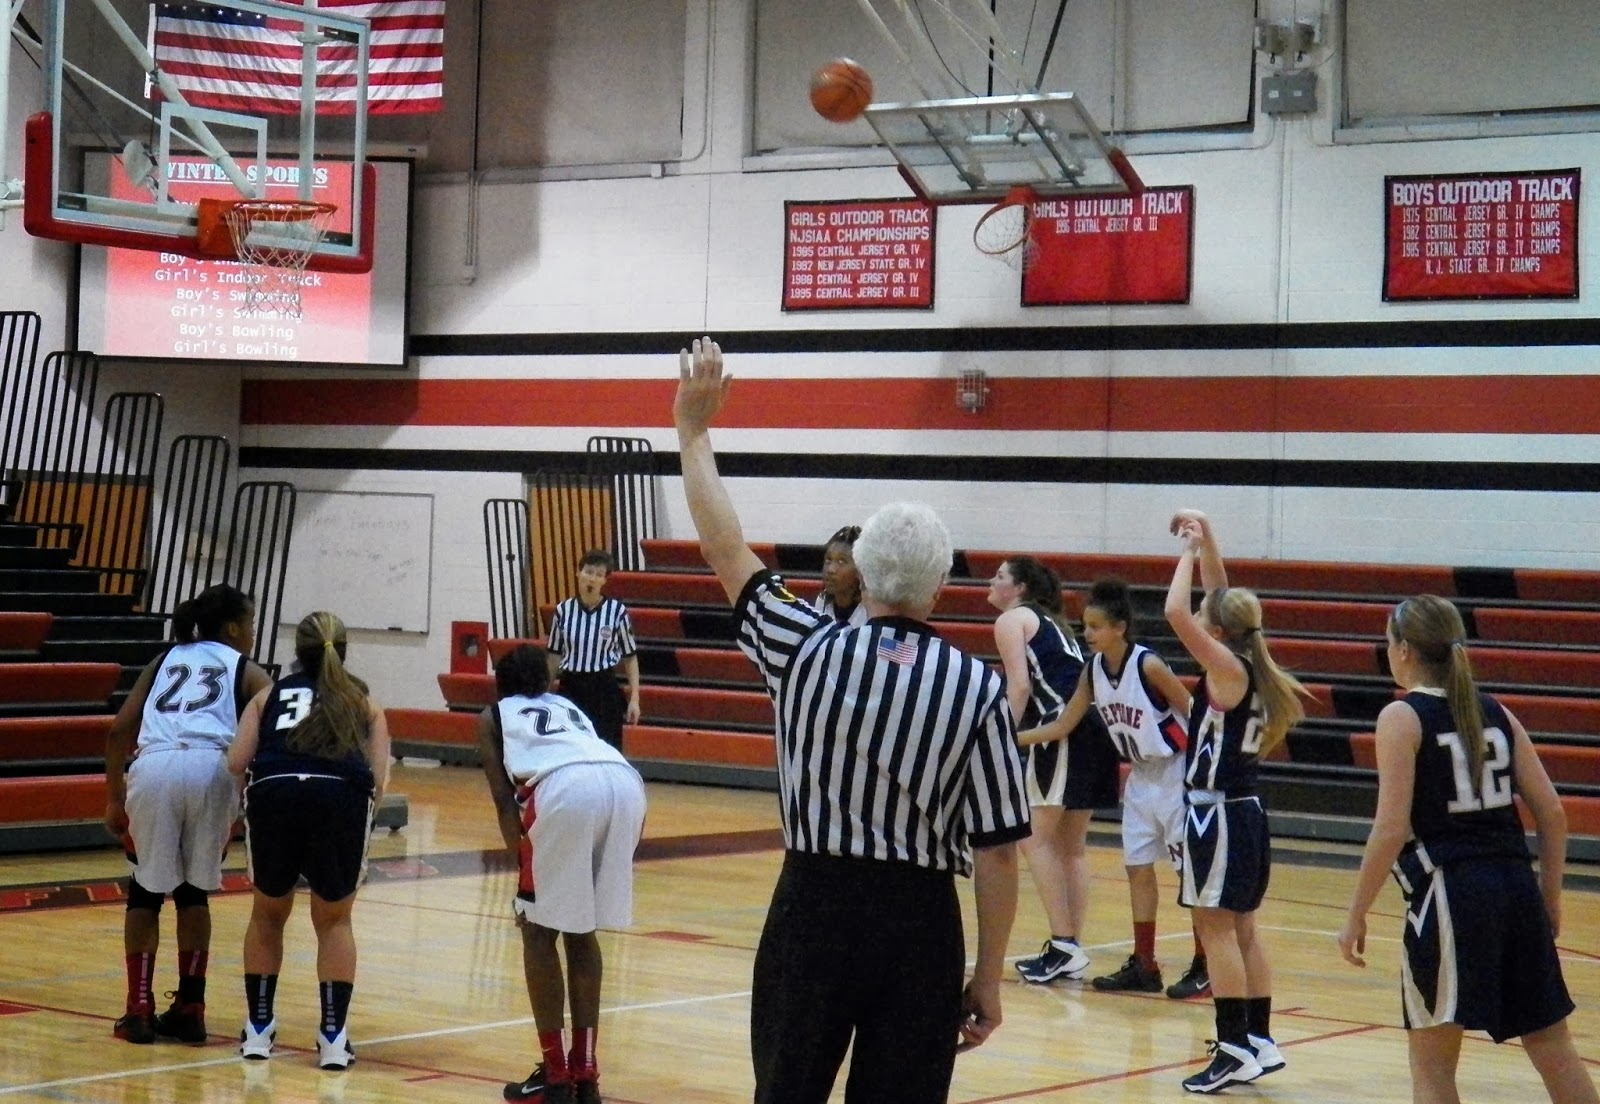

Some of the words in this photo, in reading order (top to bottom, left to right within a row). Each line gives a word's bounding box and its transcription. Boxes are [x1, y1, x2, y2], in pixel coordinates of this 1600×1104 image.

[167, 162, 240, 180] WINTE
[246, 165, 328, 184] SPORS
[1393, 182, 1434, 206] BOYS
[1438, 180, 1512, 205] OUTDOOR
[1518, 177, 1573, 202] TRACK
[1142, 191, 1183, 215] TRACK
[791, 211, 826, 226] GIRLS
[830, 210, 884, 226] OUTDOOR
[889, 208, 929, 224] TRACK
[1425, 206, 1458, 222] CENTRAL
[1464, 205, 1491, 221] JERSEY
[1515, 204, 1524, 220] IV
[1530, 203, 1560, 219] CHAMPS
[1074, 218, 1101, 233] CENTRAL
[1105, 217, 1129, 232] JERSEY
[1425, 223, 1458, 239] CENTRAL
[1464, 222, 1491, 238] JERSEY
[1515, 222, 1524, 238] IV
[1530, 221, 1560, 237] CHAMPS
[790, 229, 831, 243] NJSIAA
[837, 226, 930, 242] CHAMPIONSHIPS
[817, 245, 855, 257] CENTRAL
[858, 244, 890, 256] JERSEY
[911, 244, 920, 255] IV
[1425, 241, 1458, 257] CENTRAL
[1463, 240, 1490, 256] JERSEY
[1515, 239, 1524, 255] IV
[1530, 238, 1560, 254] CHAMPS
[160, 252, 204, 266] Boys
[817, 260, 835, 271] NEW
[837, 259, 867, 270] JERSEY
[869, 259, 896, 270] STATE
[916, 258, 926, 269] IV
[1449, 258, 1472, 274] STATE
[1496, 257, 1504, 273] IV
[1510, 257, 1540, 273] CHAMPS
[155, 269, 208, 282] Girl's
[817, 273, 853, 285] CENTRAL
[857, 272, 889, 284] JERSEY
[909, 272, 919, 283] IV
[176, 287, 220, 301] Boy's
[816, 287, 853, 299] CENTRAL
[857, 286, 888, 298] JERSEY
[171, 305, 224, 319] Girl's
[180, 324, 223, 337] Boy's
[233, 325, 294, 341] Bowling
[174, 341, 227, 354] Girl's
[237, 343, 299, 358] Bowling
[154, 663, 228, 714] 23
[1436, 726, 1512, 814] 12
